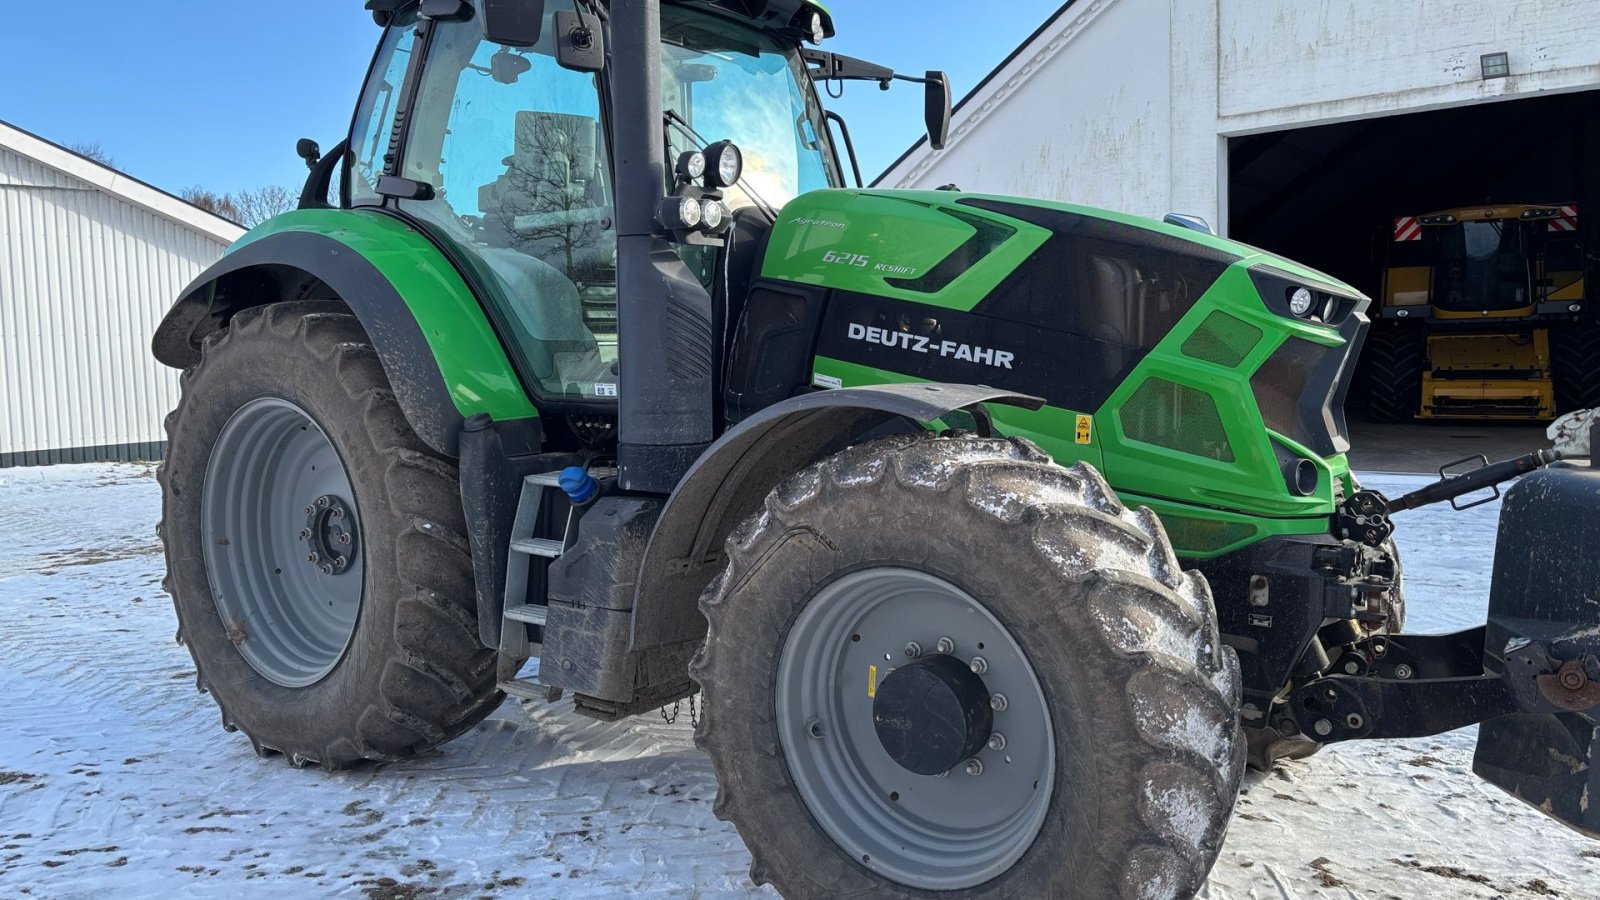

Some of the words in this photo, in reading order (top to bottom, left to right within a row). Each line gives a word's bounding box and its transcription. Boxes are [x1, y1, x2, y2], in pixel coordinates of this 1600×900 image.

[788, 217, 846, 229] Agrotron
[822, 250, 870, 268] 6215
[874, 263, 917, 275] RCSHIFT
[848, 322, 1015, 370] DEUTZ-FAHR
